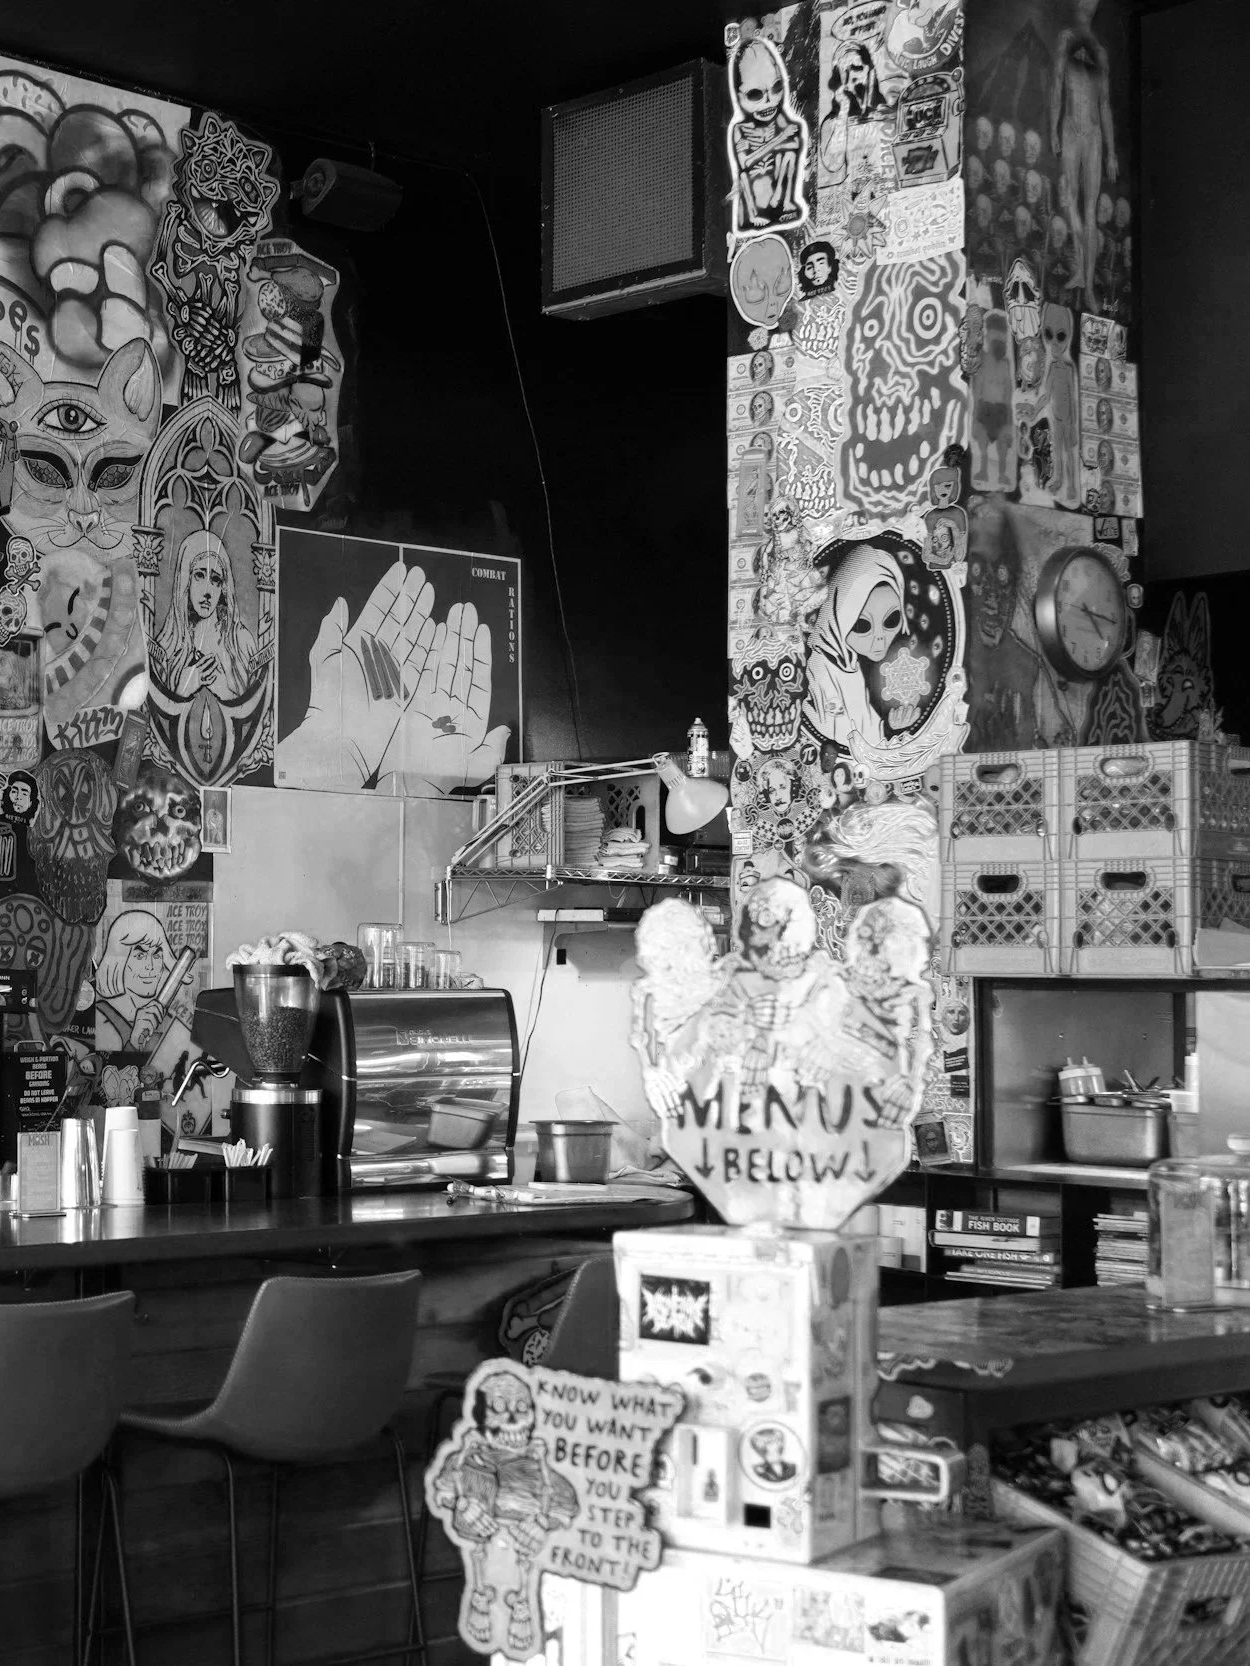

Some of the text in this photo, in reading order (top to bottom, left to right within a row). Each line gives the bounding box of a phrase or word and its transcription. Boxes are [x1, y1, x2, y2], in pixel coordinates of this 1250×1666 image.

[471, 567, 507, 581] COMBAT
[508, 587, 516, 663] RATIONS
[167, 904, 208, 918] ACE TROY
[25, 1070, 52, 1080] BEFORE
[677, 1080, 882, 1135] MENUS
[723, 1148, 850, 1184] BELOW
[968, 1220, 1021, 1233] FISH BOOK
[536, 1380, 673, 1418] KNOW WHAT
[541, 1408, 651, 1443] YOU WANT
[554, 1437, 644, 1479] BEFORE
[585, 1476, 621, 1501] YOU
[587, 1504, 635, 1529] STEP
[578, 1529, 650, 1560] TO THE
[551, 1546, 630, 1580] FRONT!
